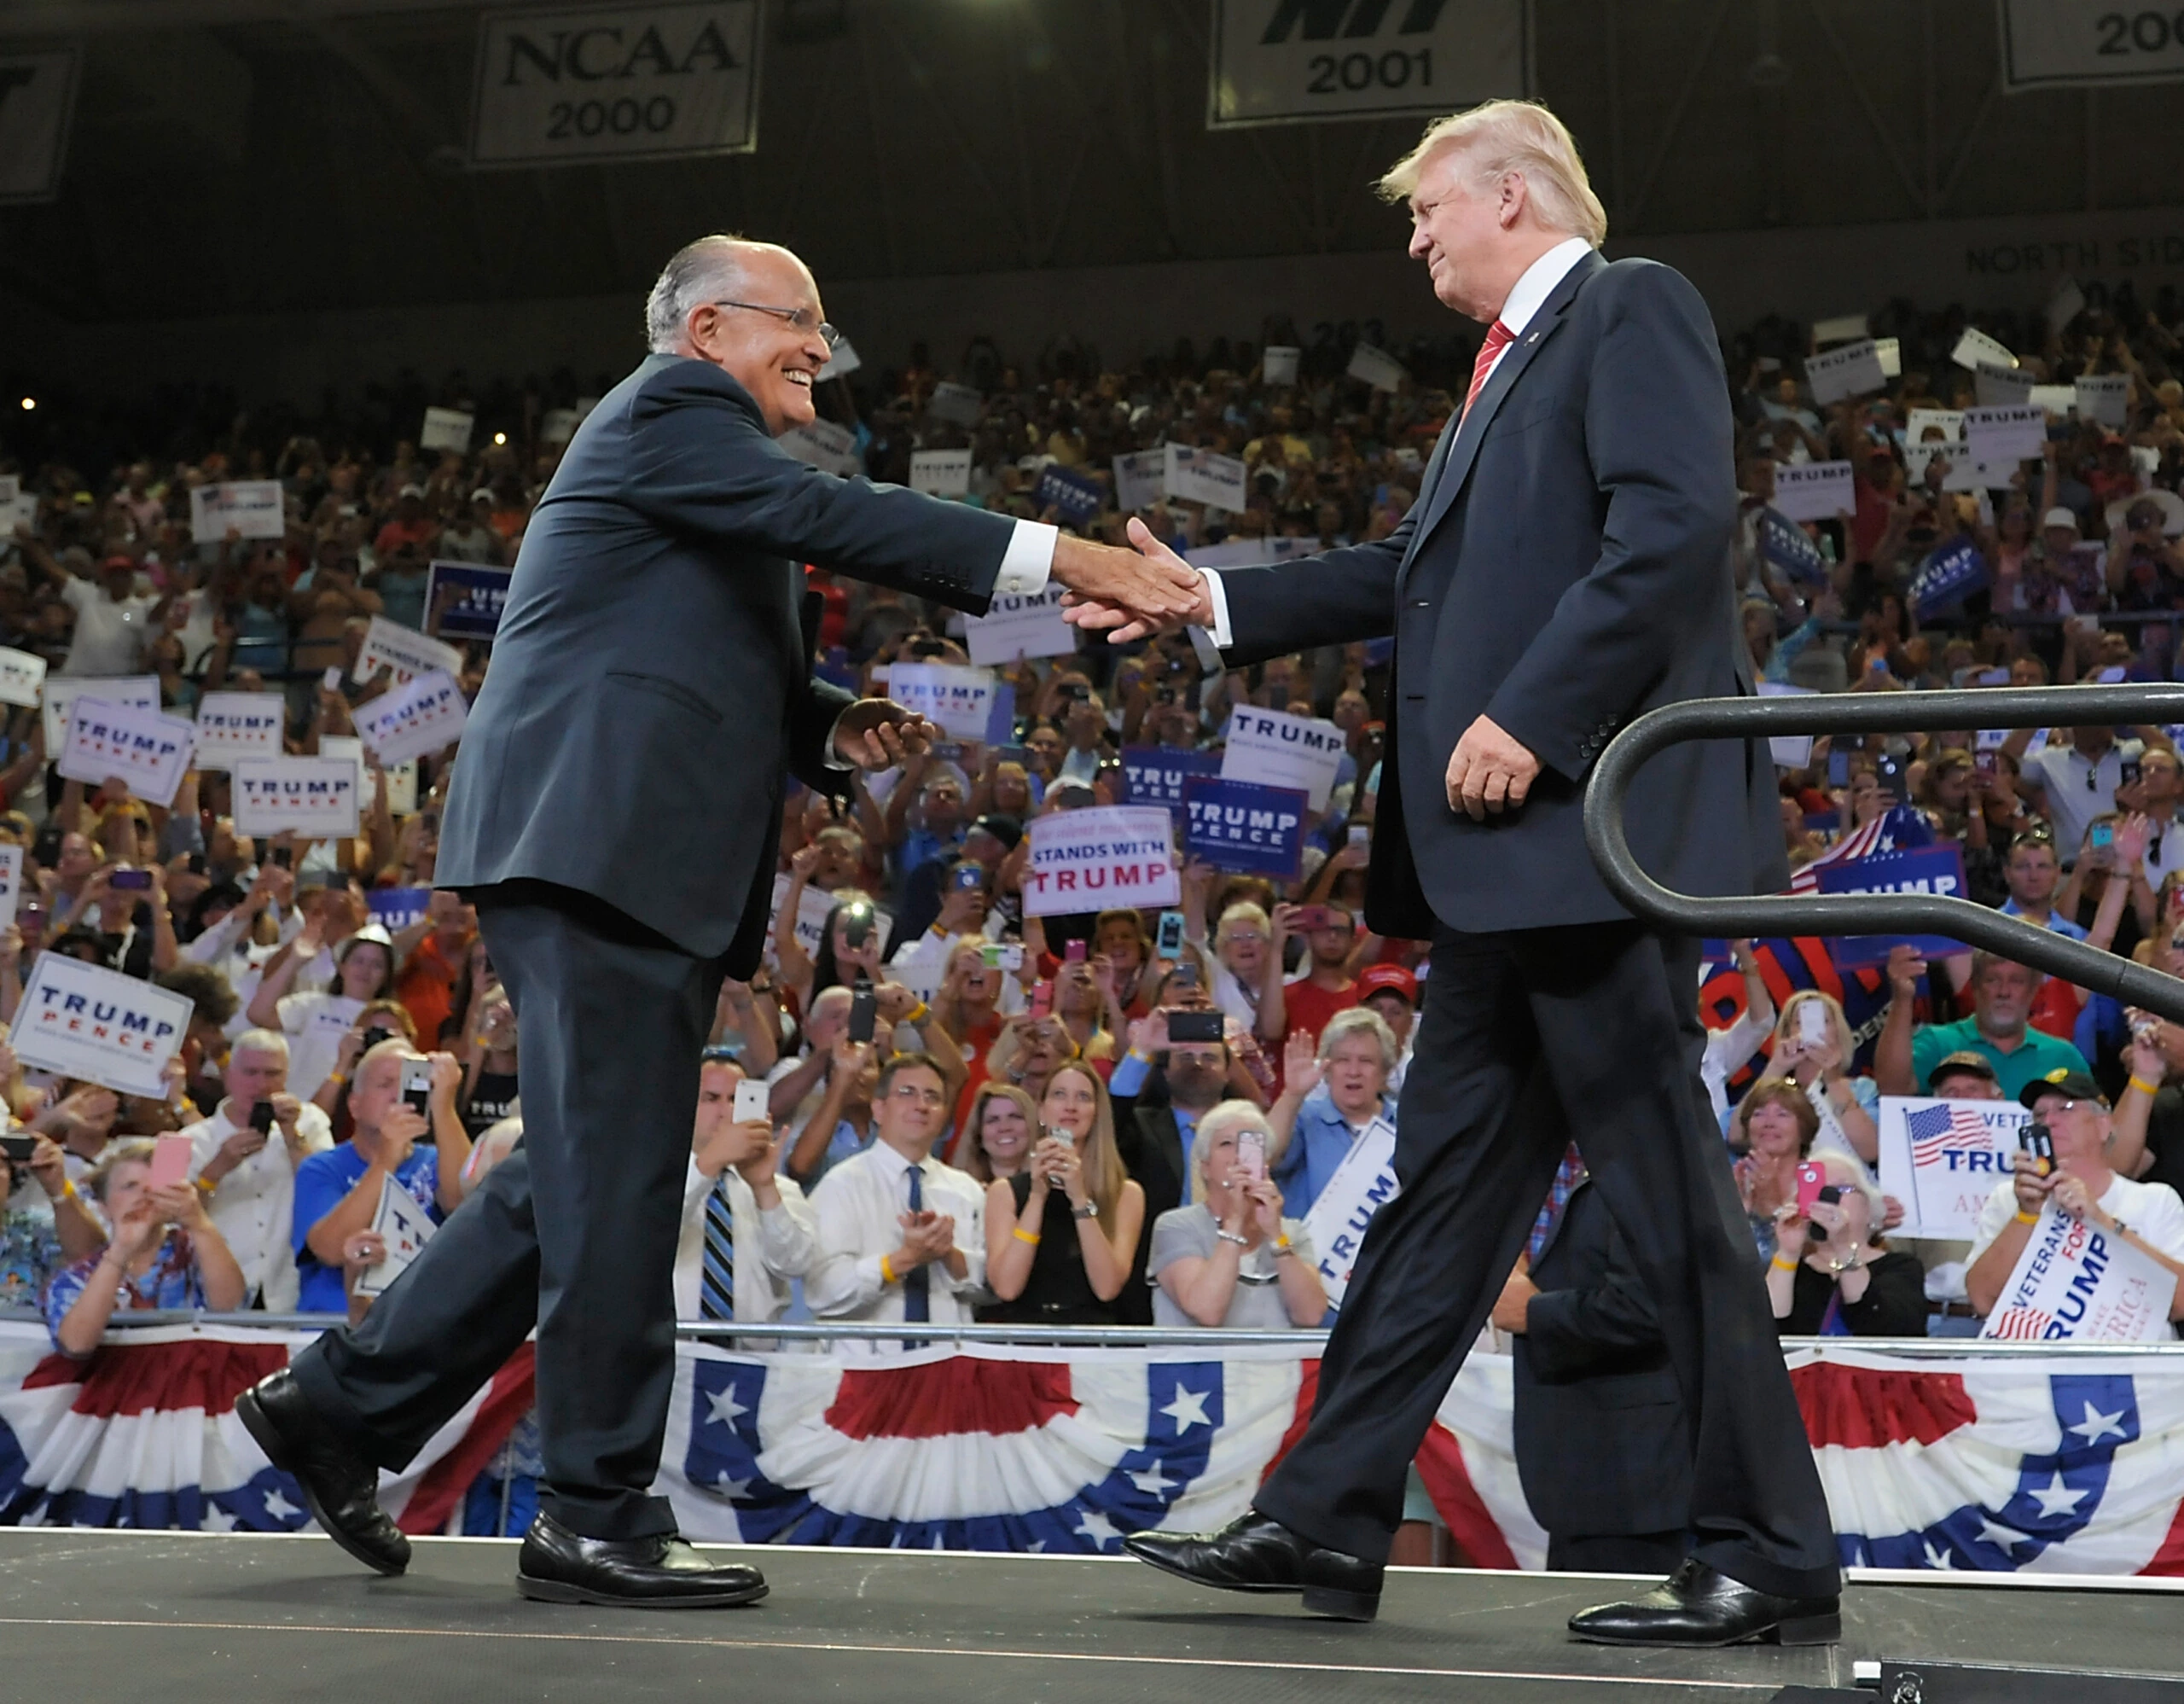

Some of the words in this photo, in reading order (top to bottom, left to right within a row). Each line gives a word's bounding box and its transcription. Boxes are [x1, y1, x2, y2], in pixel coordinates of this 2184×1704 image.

[501, 19, 745, 85] NCAA
[1306, 49, 1432, 93] 2001
[546, 95, 677, 140] 2000
[1966, 241, 2100, 274] NORTH
[1966, 410, 2042, 424] TRUMP
[1777, 468, 1850, 482] TRUMP
[898, 683, 986, 699] TRUMP
[204, 714, 276, 727] TRUMP
[366, 687, 450, 733] TRUMP
[77, 718, 177, 753] TRUMP
[1235, 715, 1341, 752] TRUMP
[242, 780, 350, 793] TRUMP
[1124, 765, 1183, 786] TRU
[1131, 784, 1181, 799] PEN
[1187, 800, 1298, 831] TRUMP
[1191, 821, 1284, 846] PENCE
[1033, 843, 1108, 864] STANDS
[1112, 841, 1165, 856] WITH
[1035, 864, 1166, 893] TRUMP
[41, 986, 175, 1037] TRUMP
[43, 1010, 155, 1052] PENCE
[1942, 1149, 2016, 1174] TRU
[1319, 1173, 1394, 1279] TRUM
[2062, 1219, 2087, 1262] FOR
[2012, 1208, 2072, 1309] VETERANS
[2043, 1233, 2110, 1340] RUMP
